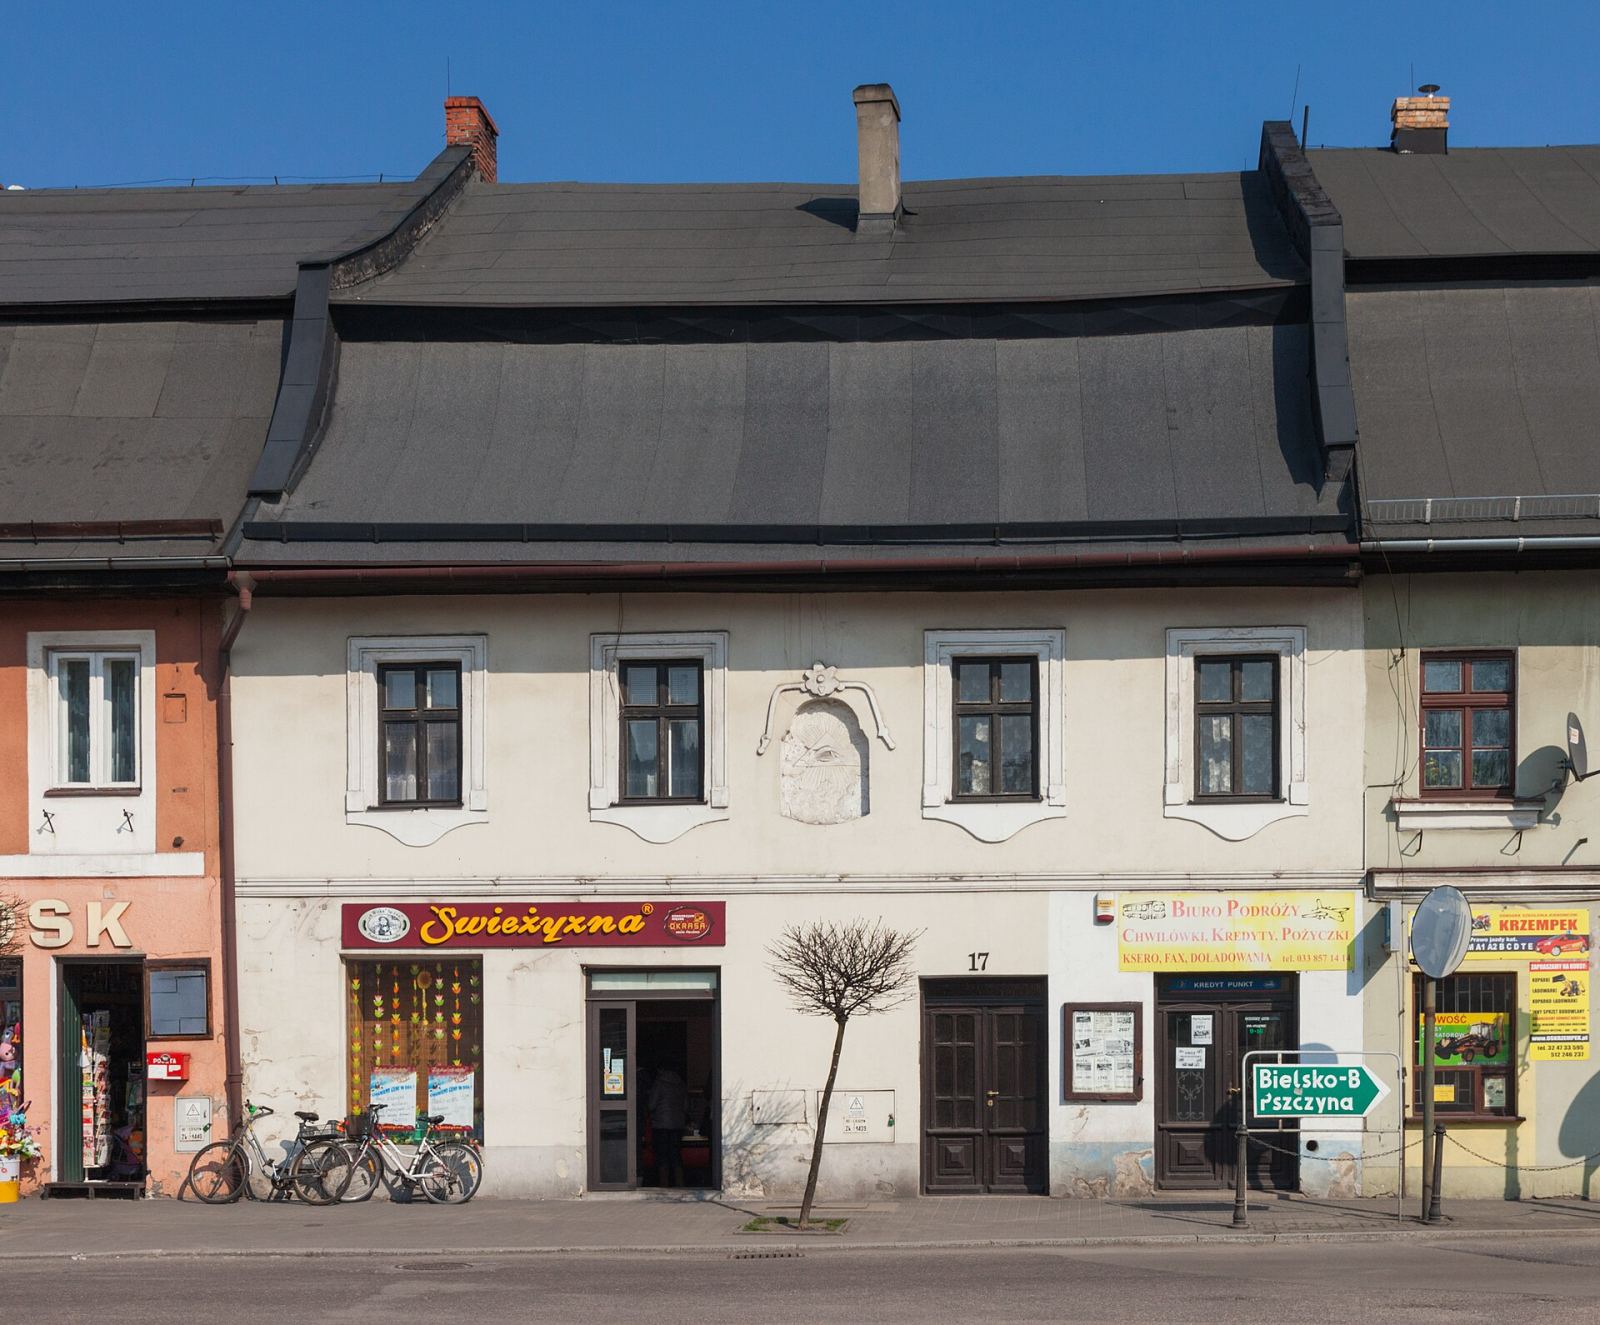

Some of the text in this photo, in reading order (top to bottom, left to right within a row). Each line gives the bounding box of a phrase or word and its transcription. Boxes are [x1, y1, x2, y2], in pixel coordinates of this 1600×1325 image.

[1172, 898, 1299, 918] BIURO PODRÓŻY
[1499, 919, 1578, 931] KRZEMPEK
[1282, 927, 1349, 941] POŻYCZKI
[968, 952, 989, 971] 17
[1123, 953, 1162, 964] KSERO,
[1164, 953, 1188, 964] FAX,
[1282, 954, 1295, 963] tel.
[1296, 954, 1311, 963] 033
[1313, 954, 1328, 962] 857
[1330, 954, 1340, 962] 14
[1259, 1068, 1361, 1089] Bielsko-B
